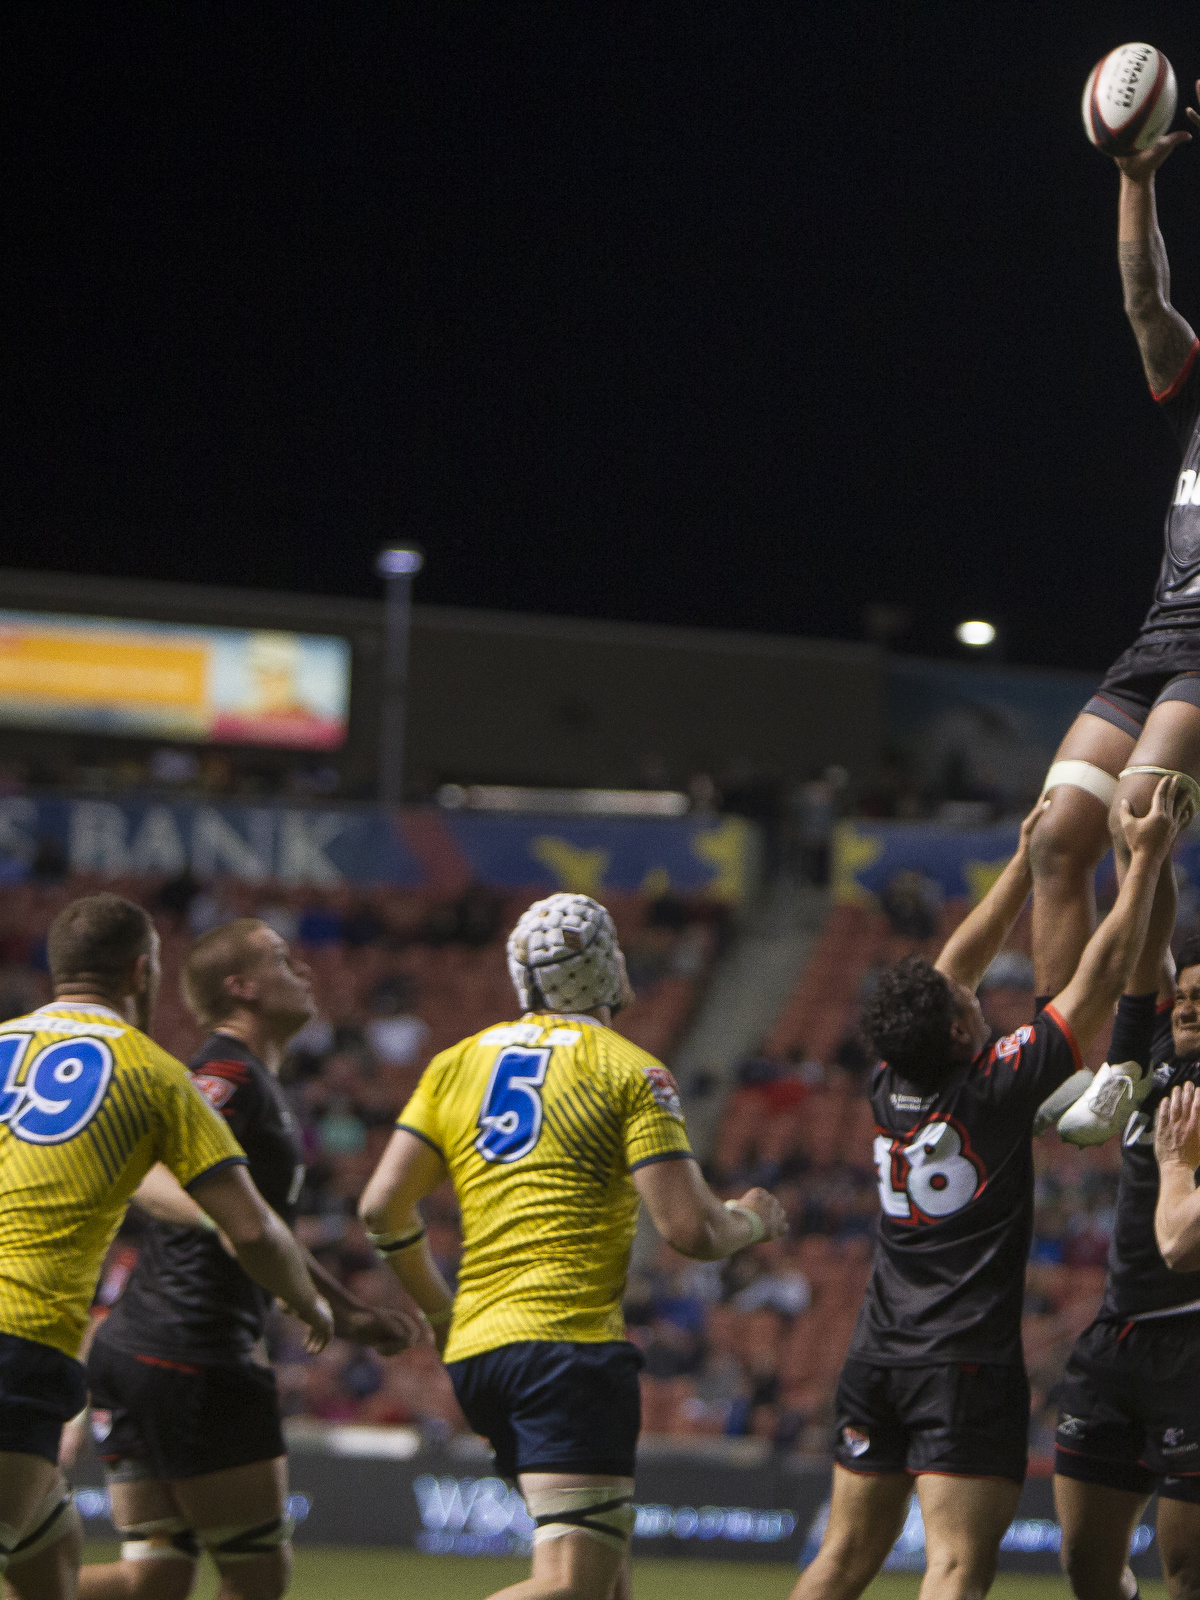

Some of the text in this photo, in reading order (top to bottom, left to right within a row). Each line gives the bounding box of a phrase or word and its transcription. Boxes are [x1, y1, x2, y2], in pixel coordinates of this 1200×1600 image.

[67, 800, 350, 884] BANK
[473, 1044, 553, 1164] 5
[873, 1118, 984, 1220] 18
